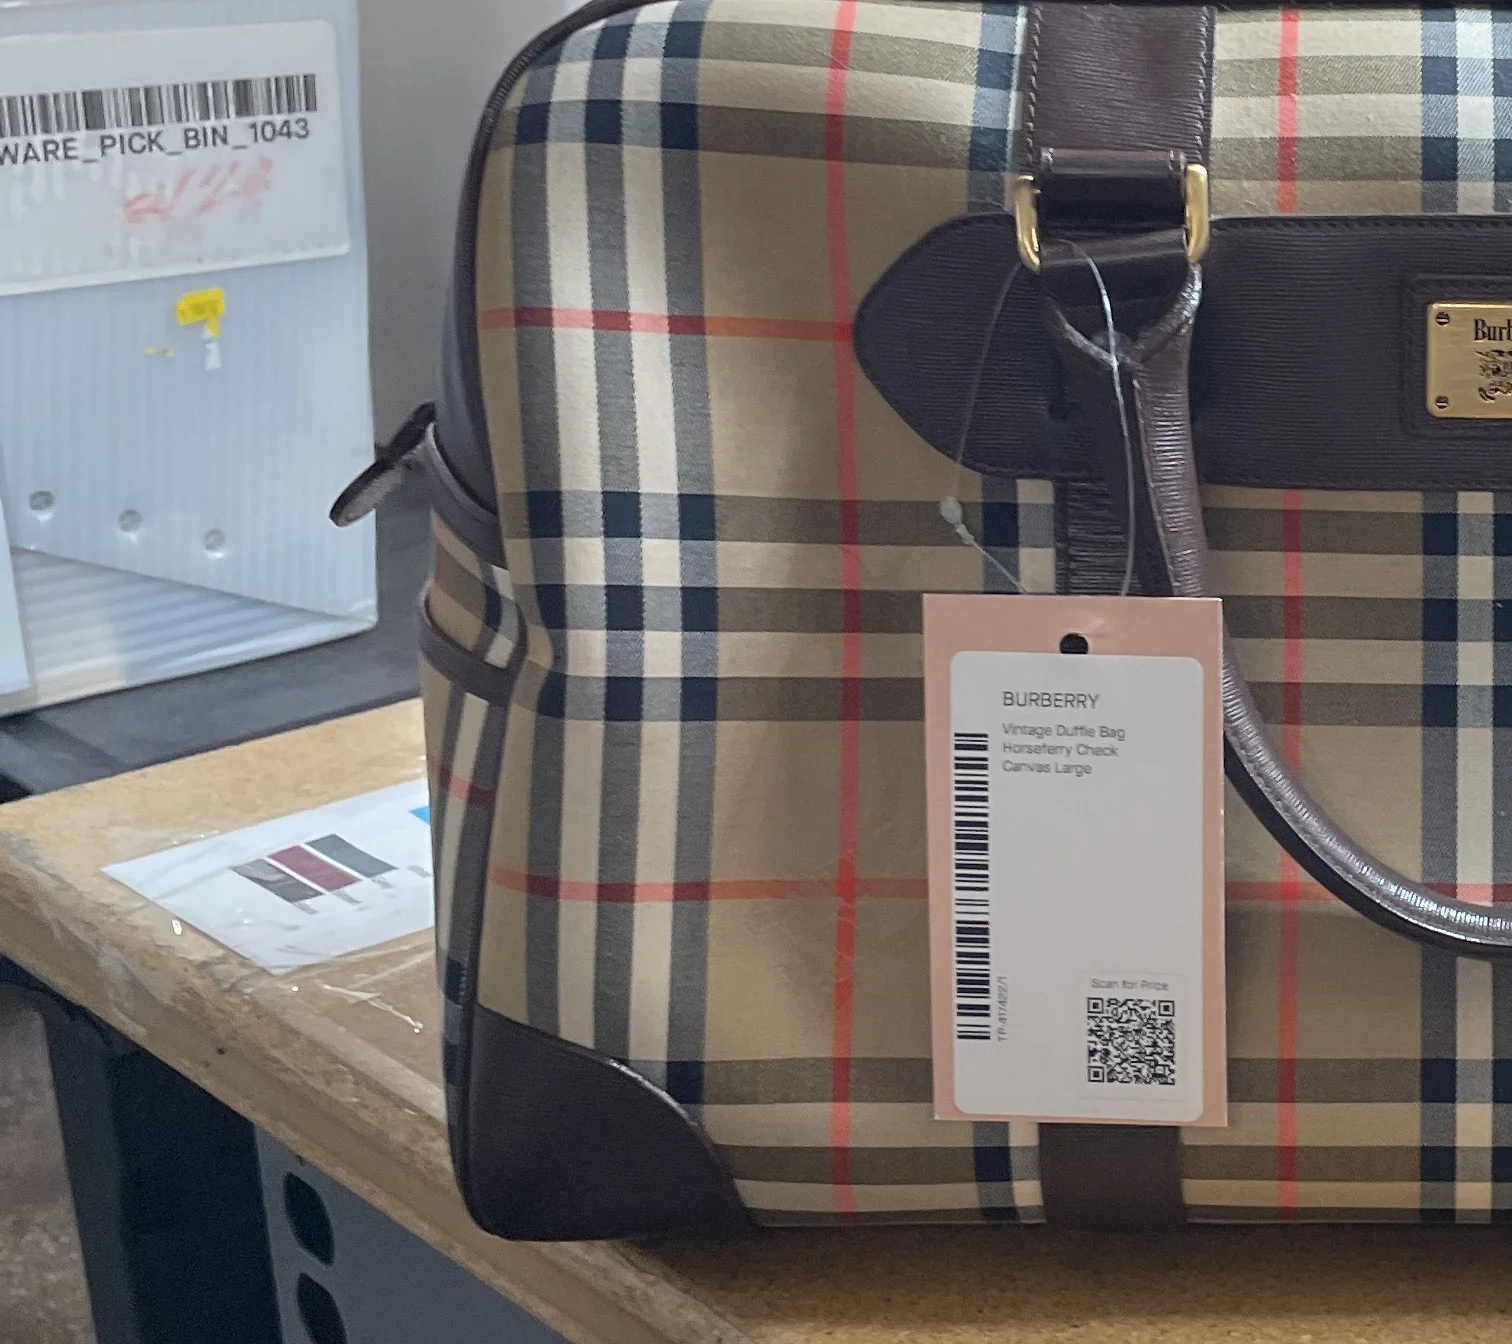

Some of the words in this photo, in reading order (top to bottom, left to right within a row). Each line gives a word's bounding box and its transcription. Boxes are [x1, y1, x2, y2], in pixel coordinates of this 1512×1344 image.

[1003, 690, 1100, 709] BURBERRY
[1002, 723, 1053, 739] Vintage
[1056, 724, 1096, 738] Duffle
[1099, 726, 1126, 742] Bag
[1003, 742, 1072, 757] Horseferry
[1076, 743, 1118, 757] Check
[1002, 759, 1051, 773] Canvas
[1055, 762, 1092, 777] Large
[1091, 978, 1118, 989] Scan
[1140, 980, 1168, 991] Price
